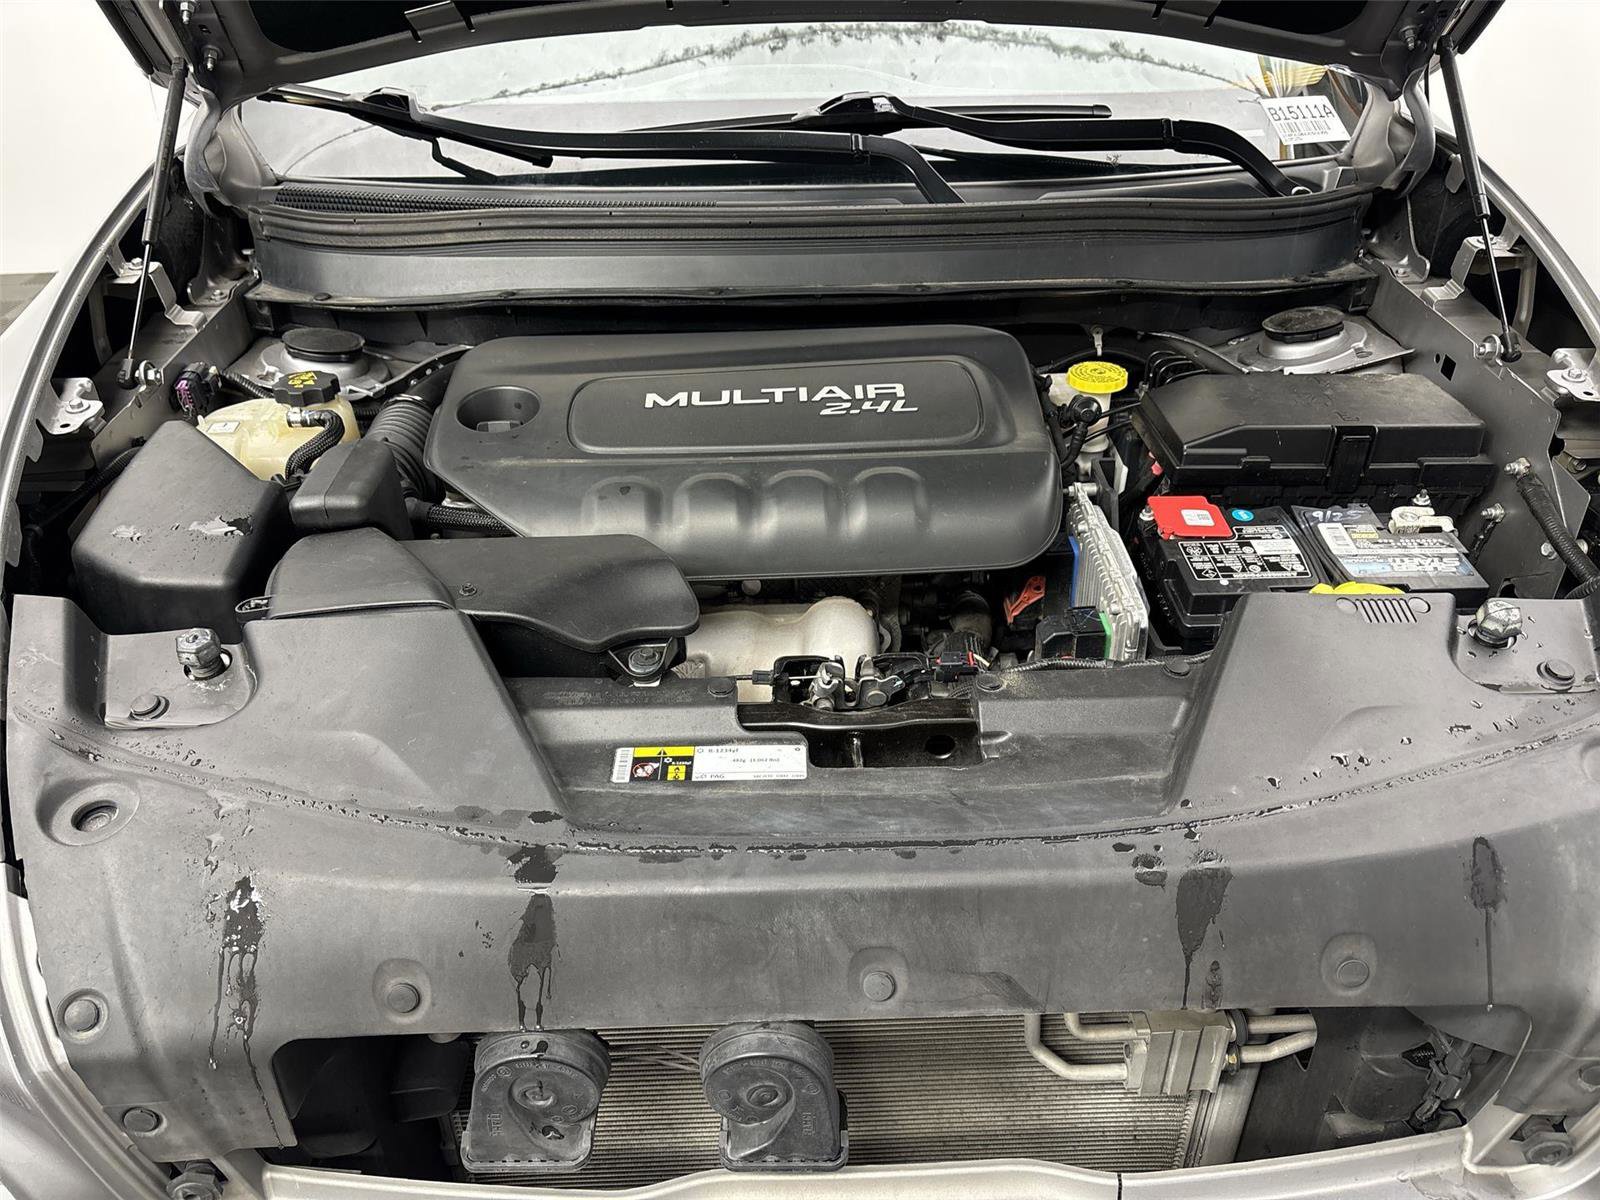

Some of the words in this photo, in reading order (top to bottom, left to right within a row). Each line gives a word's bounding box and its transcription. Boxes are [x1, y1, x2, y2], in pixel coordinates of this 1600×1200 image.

[1267, 103, 1336, 121] B15111A
[644, 383, 905, 408] MULTIAIR
[819, 399, 919, 415] 2.4L
